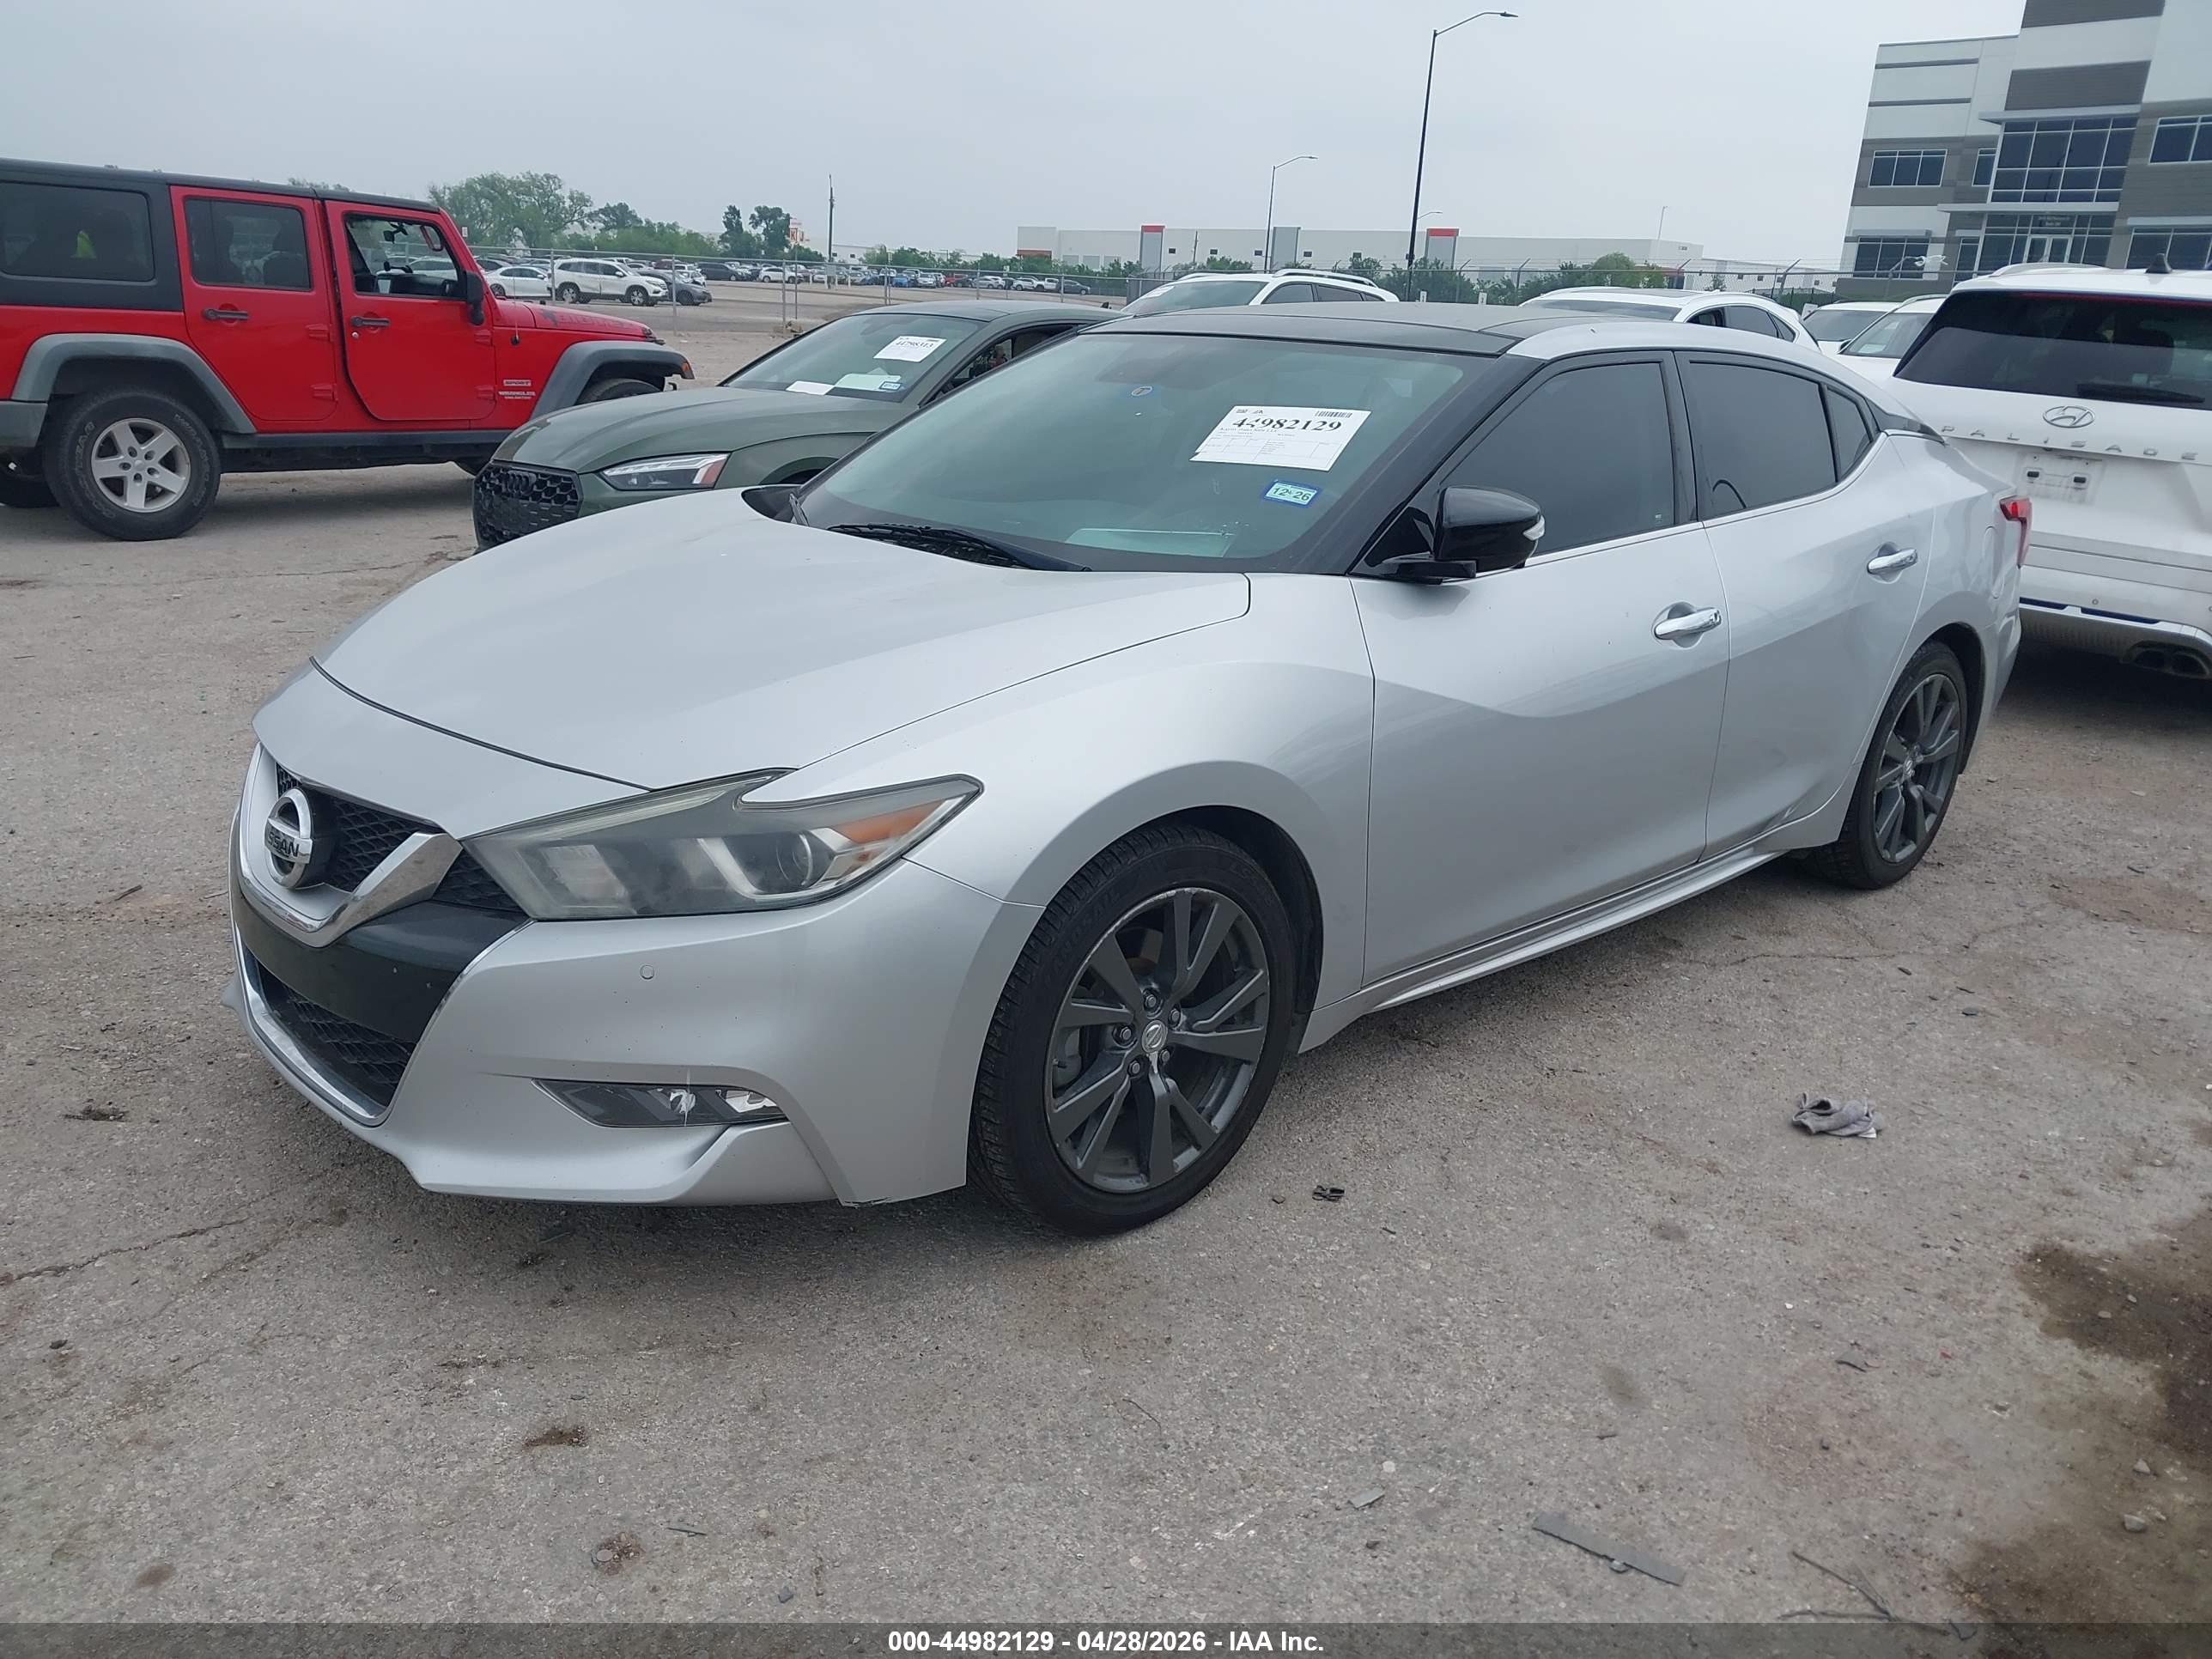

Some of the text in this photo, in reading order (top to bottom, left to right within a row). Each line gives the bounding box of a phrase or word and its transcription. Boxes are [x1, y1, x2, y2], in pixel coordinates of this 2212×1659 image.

[1232, 417, 1342, 432] 44982129
[1941, 425, 2199, 461] PALISADE
[1273, 487, 1311, 501] 12 26
[267, 831, 300, 858] SSAN
